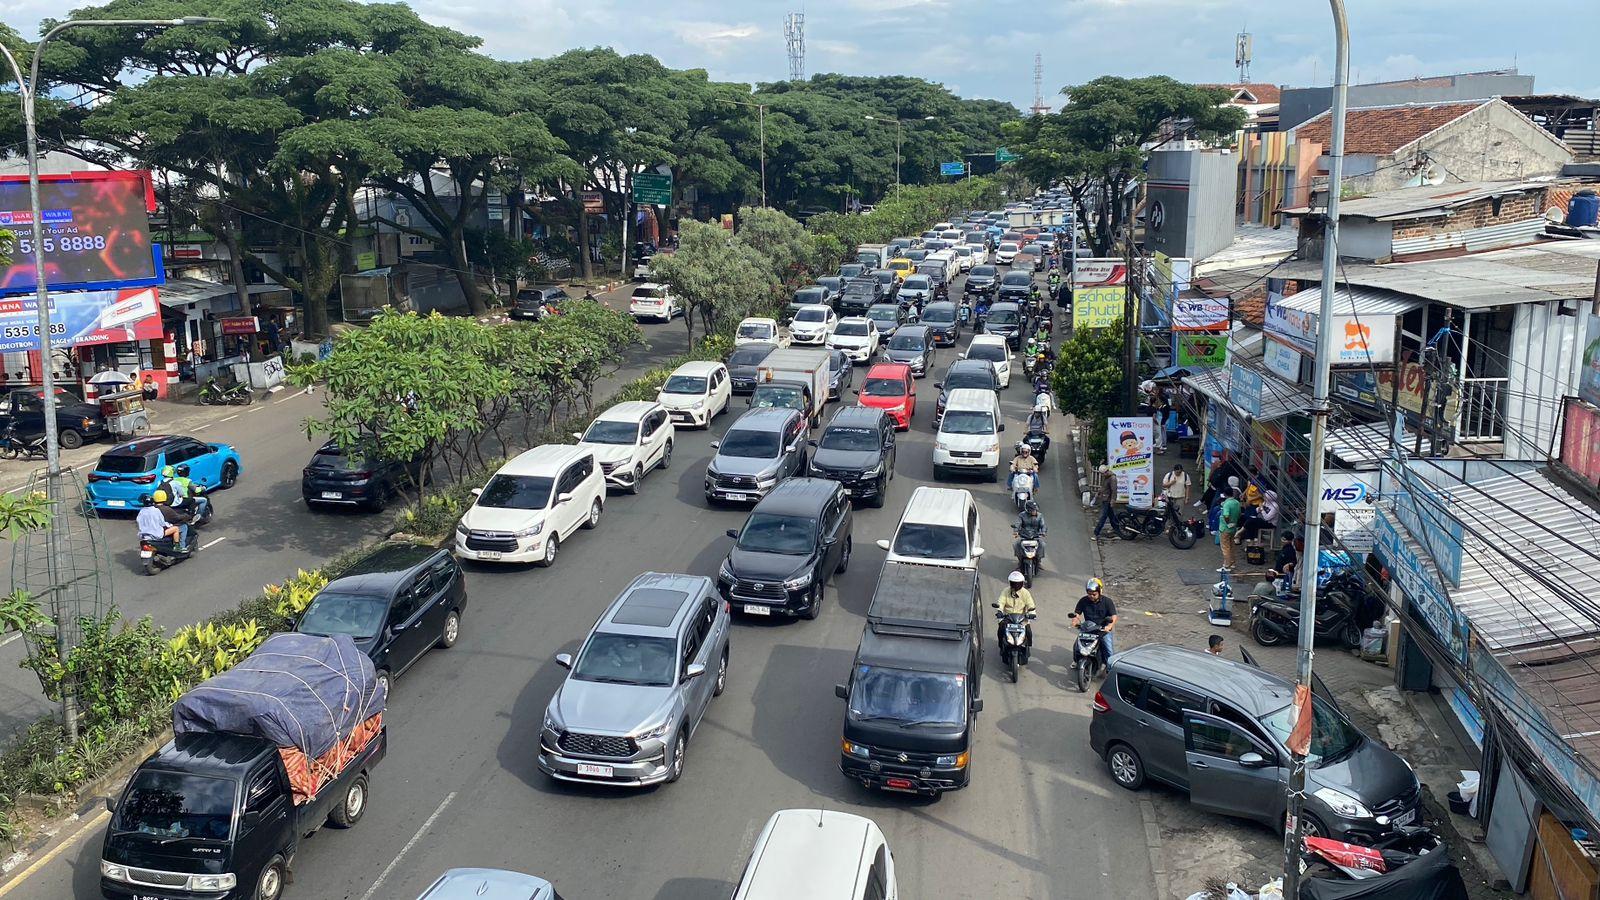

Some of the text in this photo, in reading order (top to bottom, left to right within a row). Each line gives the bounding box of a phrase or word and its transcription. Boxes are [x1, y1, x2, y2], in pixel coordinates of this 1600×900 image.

[14, 228, 32, 237] Spot
[66, 226, 78, 234] Ad
[60, 235, 106, 252] 8888
[1188, 303, 1228, 312] WB Trans
[5, 323, 66, 338] 535 888
[0, 341, 33, 350] IDEOTRON
[75, 334, 110, 343] BRANDING
[1119, 421, 1151, 429] WB Trans
[1119, 454, 1147, 463] DISCOUNT
